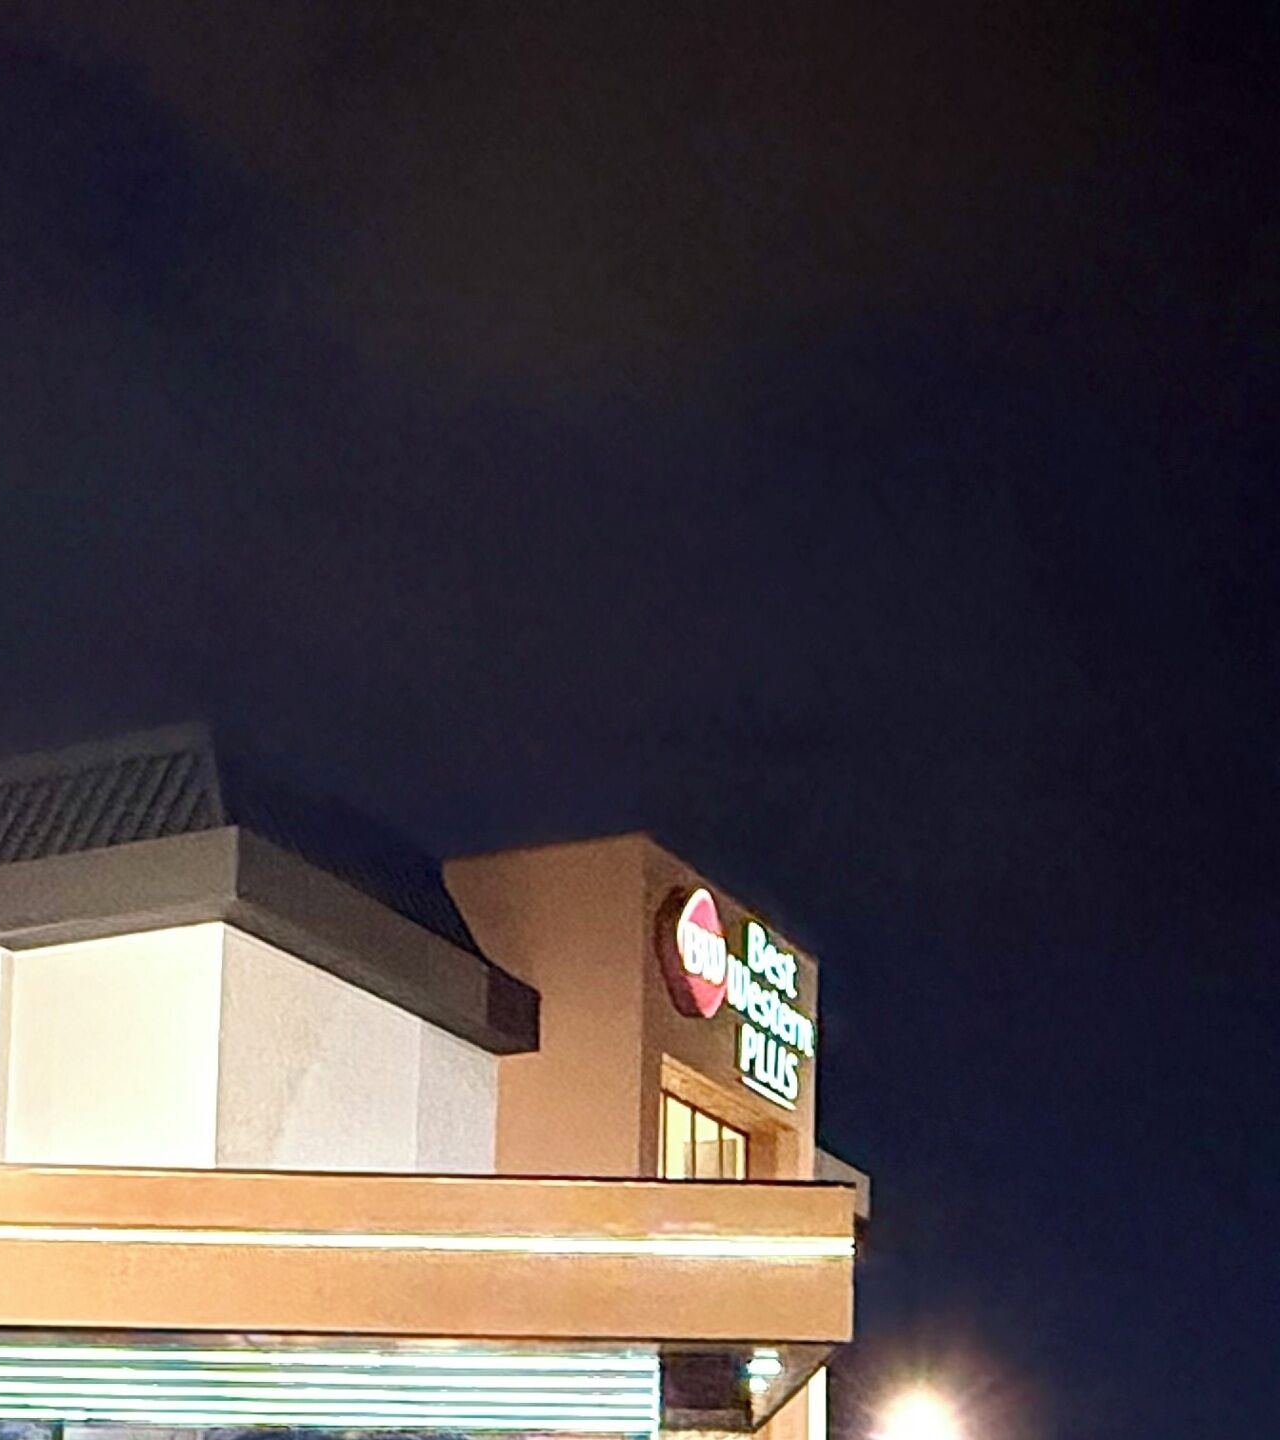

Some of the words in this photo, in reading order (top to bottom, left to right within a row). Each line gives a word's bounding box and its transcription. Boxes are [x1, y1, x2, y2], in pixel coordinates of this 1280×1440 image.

[683, 922, 726, 985] BW
[747, 921, 798, 999] Best
[727, 955, 815, 1058] Western
[739, 1022, 799, 1100] PLUS
